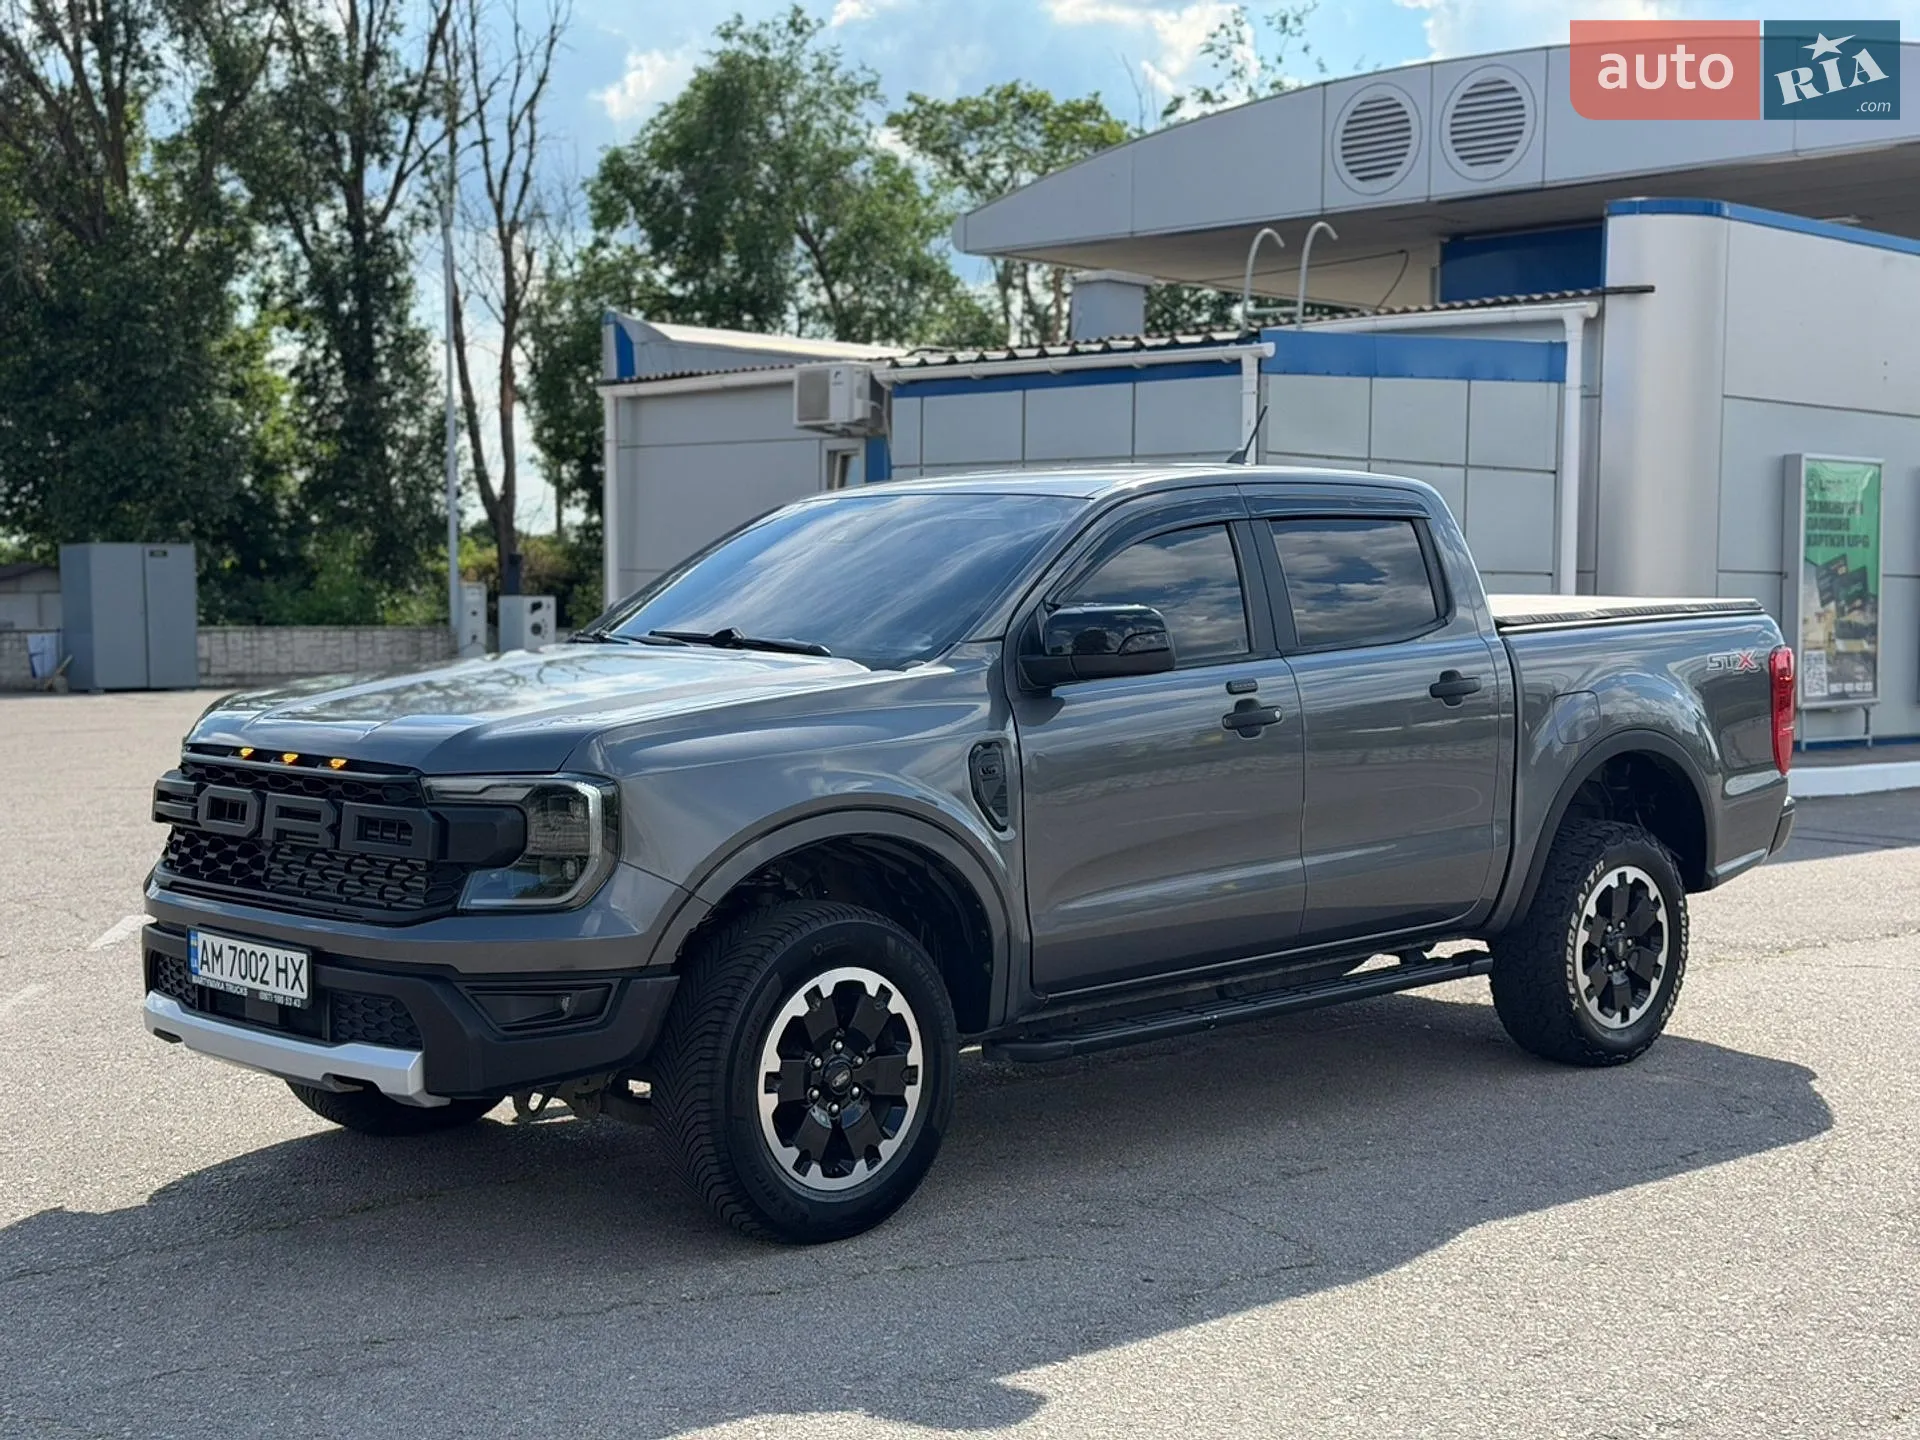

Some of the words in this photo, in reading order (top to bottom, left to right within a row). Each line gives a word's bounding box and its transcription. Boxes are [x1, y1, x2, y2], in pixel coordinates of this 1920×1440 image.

[1706, 649, 1760, 674] STX
[200, 939, 224, 976] AM
[228, 945, 270, 986] 7002
[275, 955, 305, 993] HX
